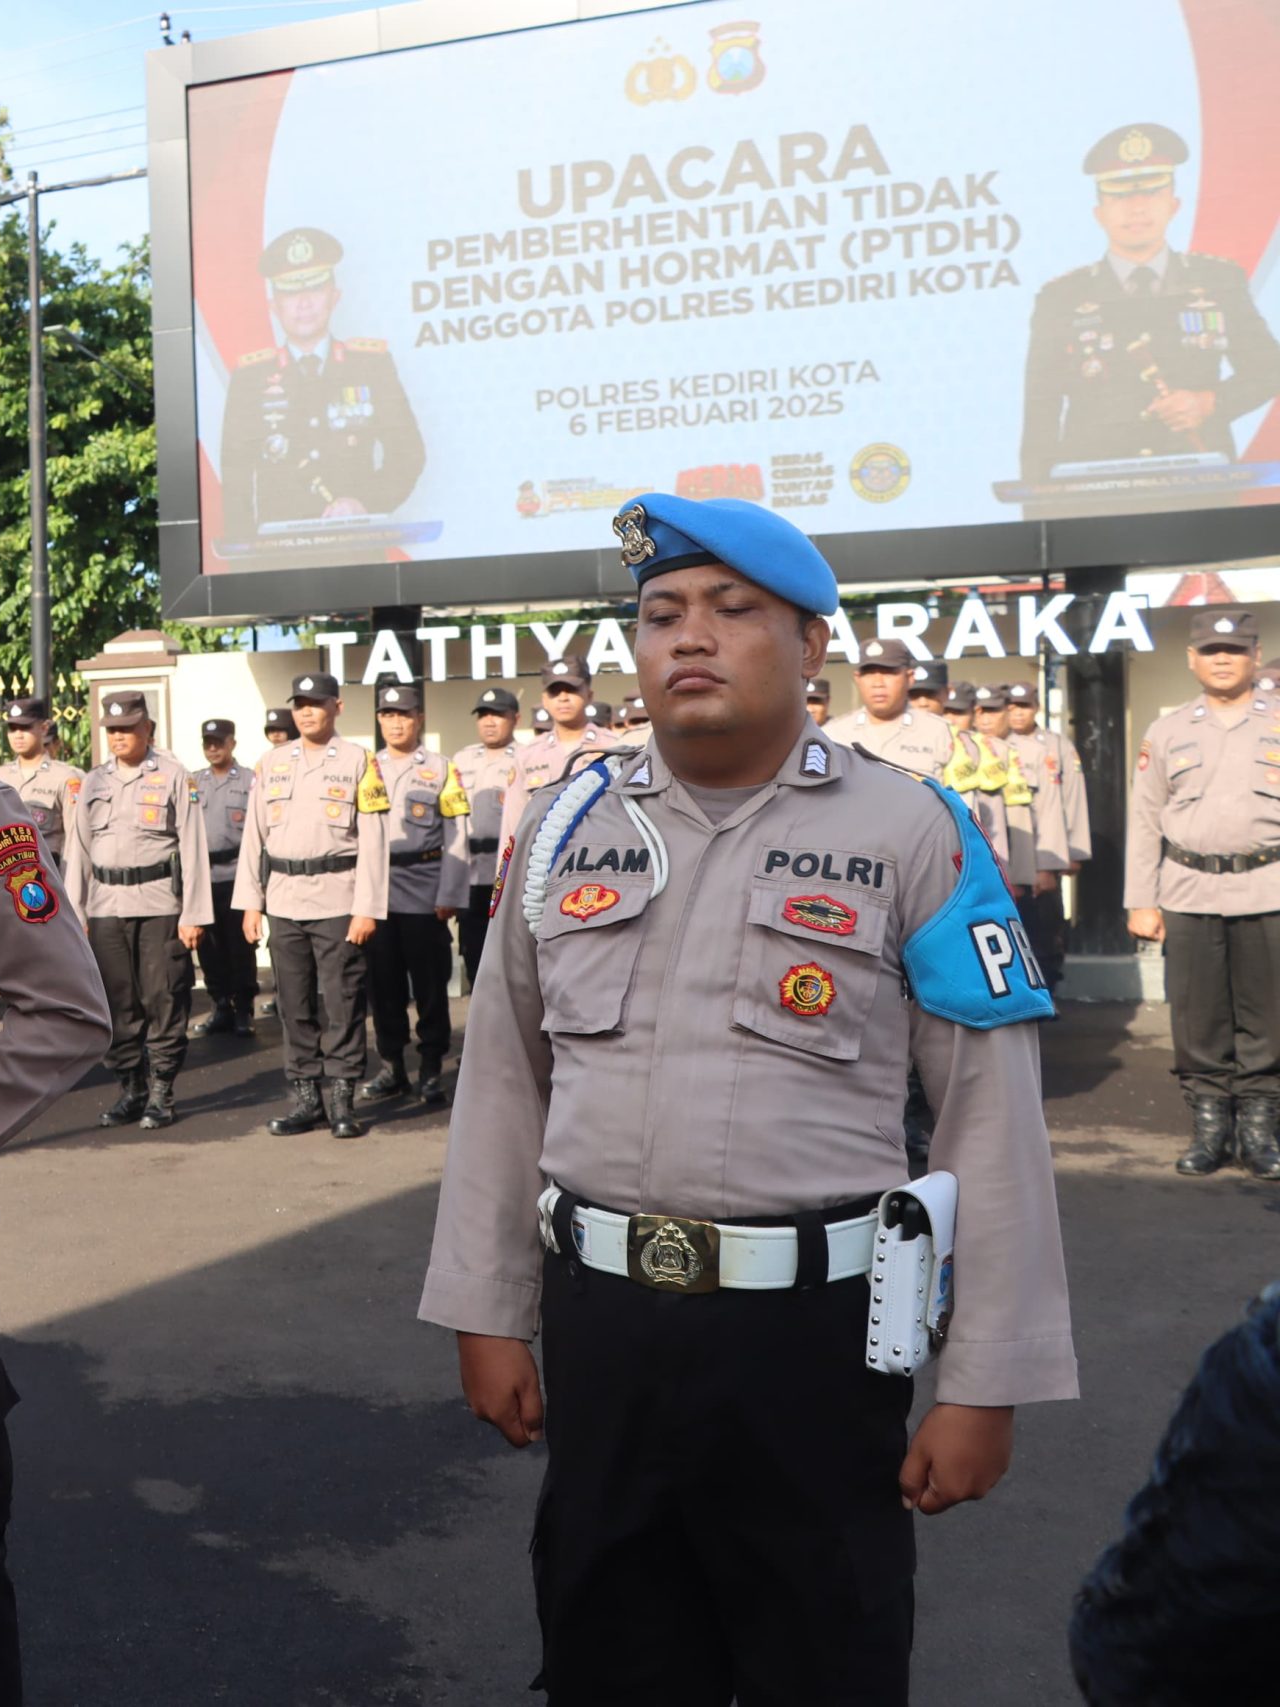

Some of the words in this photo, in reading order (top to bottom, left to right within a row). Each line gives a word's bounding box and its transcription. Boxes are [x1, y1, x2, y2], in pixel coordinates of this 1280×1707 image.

[517, 124, 890, 219] UPACARA
[427, 193, 828, 272] PEMBERHENTIAN
[844, 170, 1000, 222] TIDAK
[412, 260, 606, 313] DENGAN
[619, 235, 825, 290] HORMAT
[840, 213, 1021, 274] (PTDH)
[414, 304, 594, 348] ANGGOTA
[606, 287, 753, 328] POLRES
[765, 271, 896, 312] KEDIRI
[908, 259, 1020, 296] KOTA
[535, 379, 660, 412] POLRES
[668, 367, 778, 402] KEDIRI
[788, 359, 880, 389] KOTA
[569, 414, 588, 436] 6
[597, 398, 758, 435] FEBRUARI
[768, 390, 844, 419] 2025
[771, 452, 824, 467] KERAS
[771, 465, 834, 481] CERDAS
[771, 479, 834, 494] TUNTAS
[314, 617, 636, 686] TATHYA
[826, 591, 1154, 664] ARAKA
[323, 775, 353, 783] POLRI
[411, 779, 439, 790] POLRI
[14, 834, 35, 844] KOTA
[557, 846, 650, 878] ALAM
[764, 849, 885, 889] POLRI
